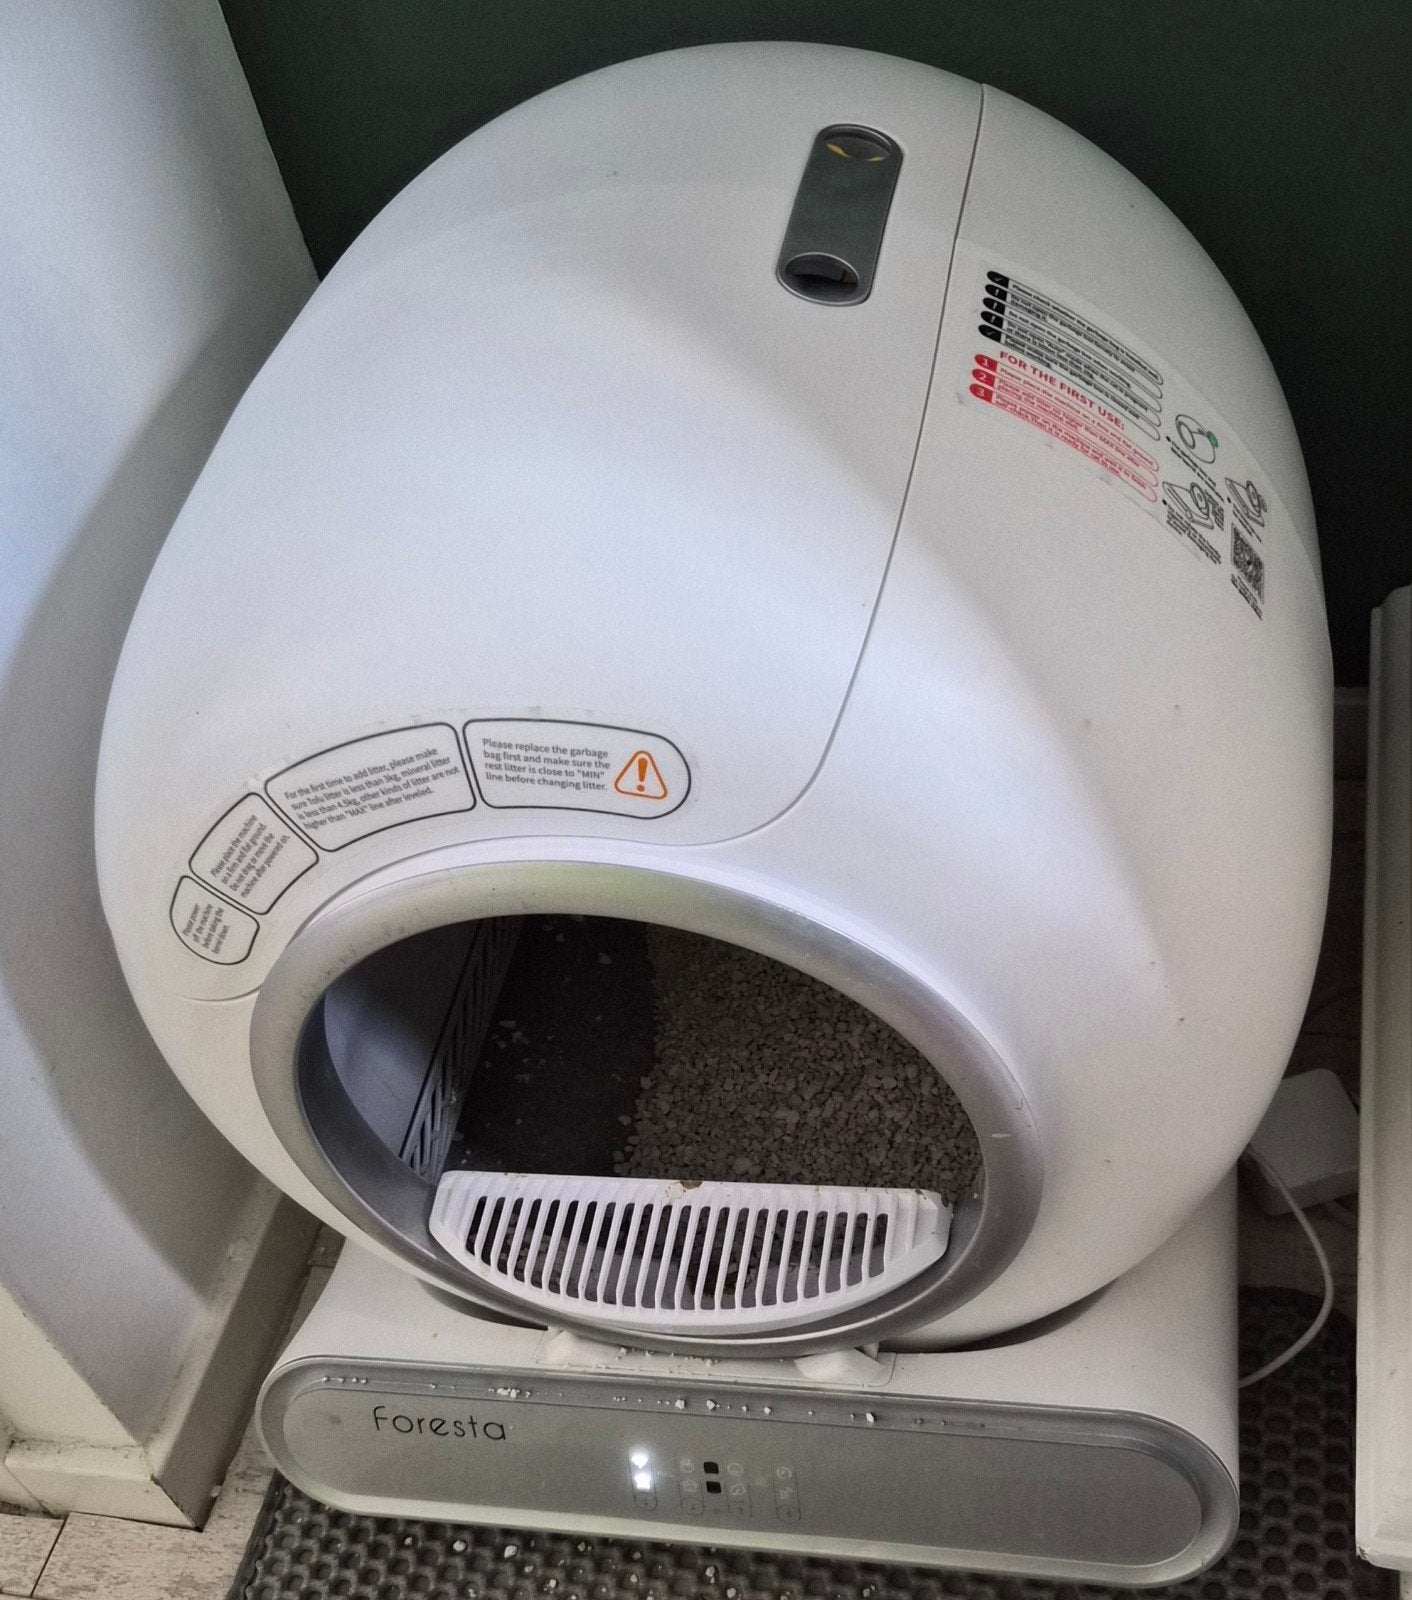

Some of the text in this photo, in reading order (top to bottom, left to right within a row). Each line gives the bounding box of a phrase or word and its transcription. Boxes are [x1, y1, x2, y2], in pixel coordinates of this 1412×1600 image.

[1000, 351, 1026, 370] FOR
[1031, 366, 1056, 386] THE
[1060, 383, 1094, 408] FIRST
[1098, 406, 1124, 430] USE:
[483, 738, 608, 761] Please replace the garbage
[483, 750, 501, 761] bag
[503, 751, 521, 761] first
[544, 757, 569, 765] make
[595, 760, 610, 769] the
[291, 801, 307, 810] sure
[306, 795, 325, 805] Tofu
[323, 791, 342, 800] litter
[349, 784, 365, 793] less
[365, 779, 384, 788] than
[401, 762, 431, 777] mineral
[431, 757, 450, 767] litter
[297, 788, 311, 796] the
[310, 783, 326, 792] first
[325, 778, 344, 788] time
[353, 769, 368, 780] add
[367, 765, 390, 775] litter,
[389, 756, 415, 770] please
[415, 749, 438, 760] make
[485, 763, 502, 771] rest
[504, 763, 526, 772] litter
[529, 765, 536, 774] is
[538, 767, 562, 776] close
[577, 770, 604, 779] "MIN"
[486, 772, 606, 790] line before changing litter.
[303, 810, 320, 818] less
[319, 805, 337, 814] than
[360, 791, 380, 802] other
[379, 785, 403, 795] kinds
[402, 780, 411, 789] of
[410, 776, 430, 786] litter
[431, 772, 444, 780] are
[303, 787, 434, 829] higher than "MAX" line after leveled.
[373, 1405, 506, 1440] Foresta
